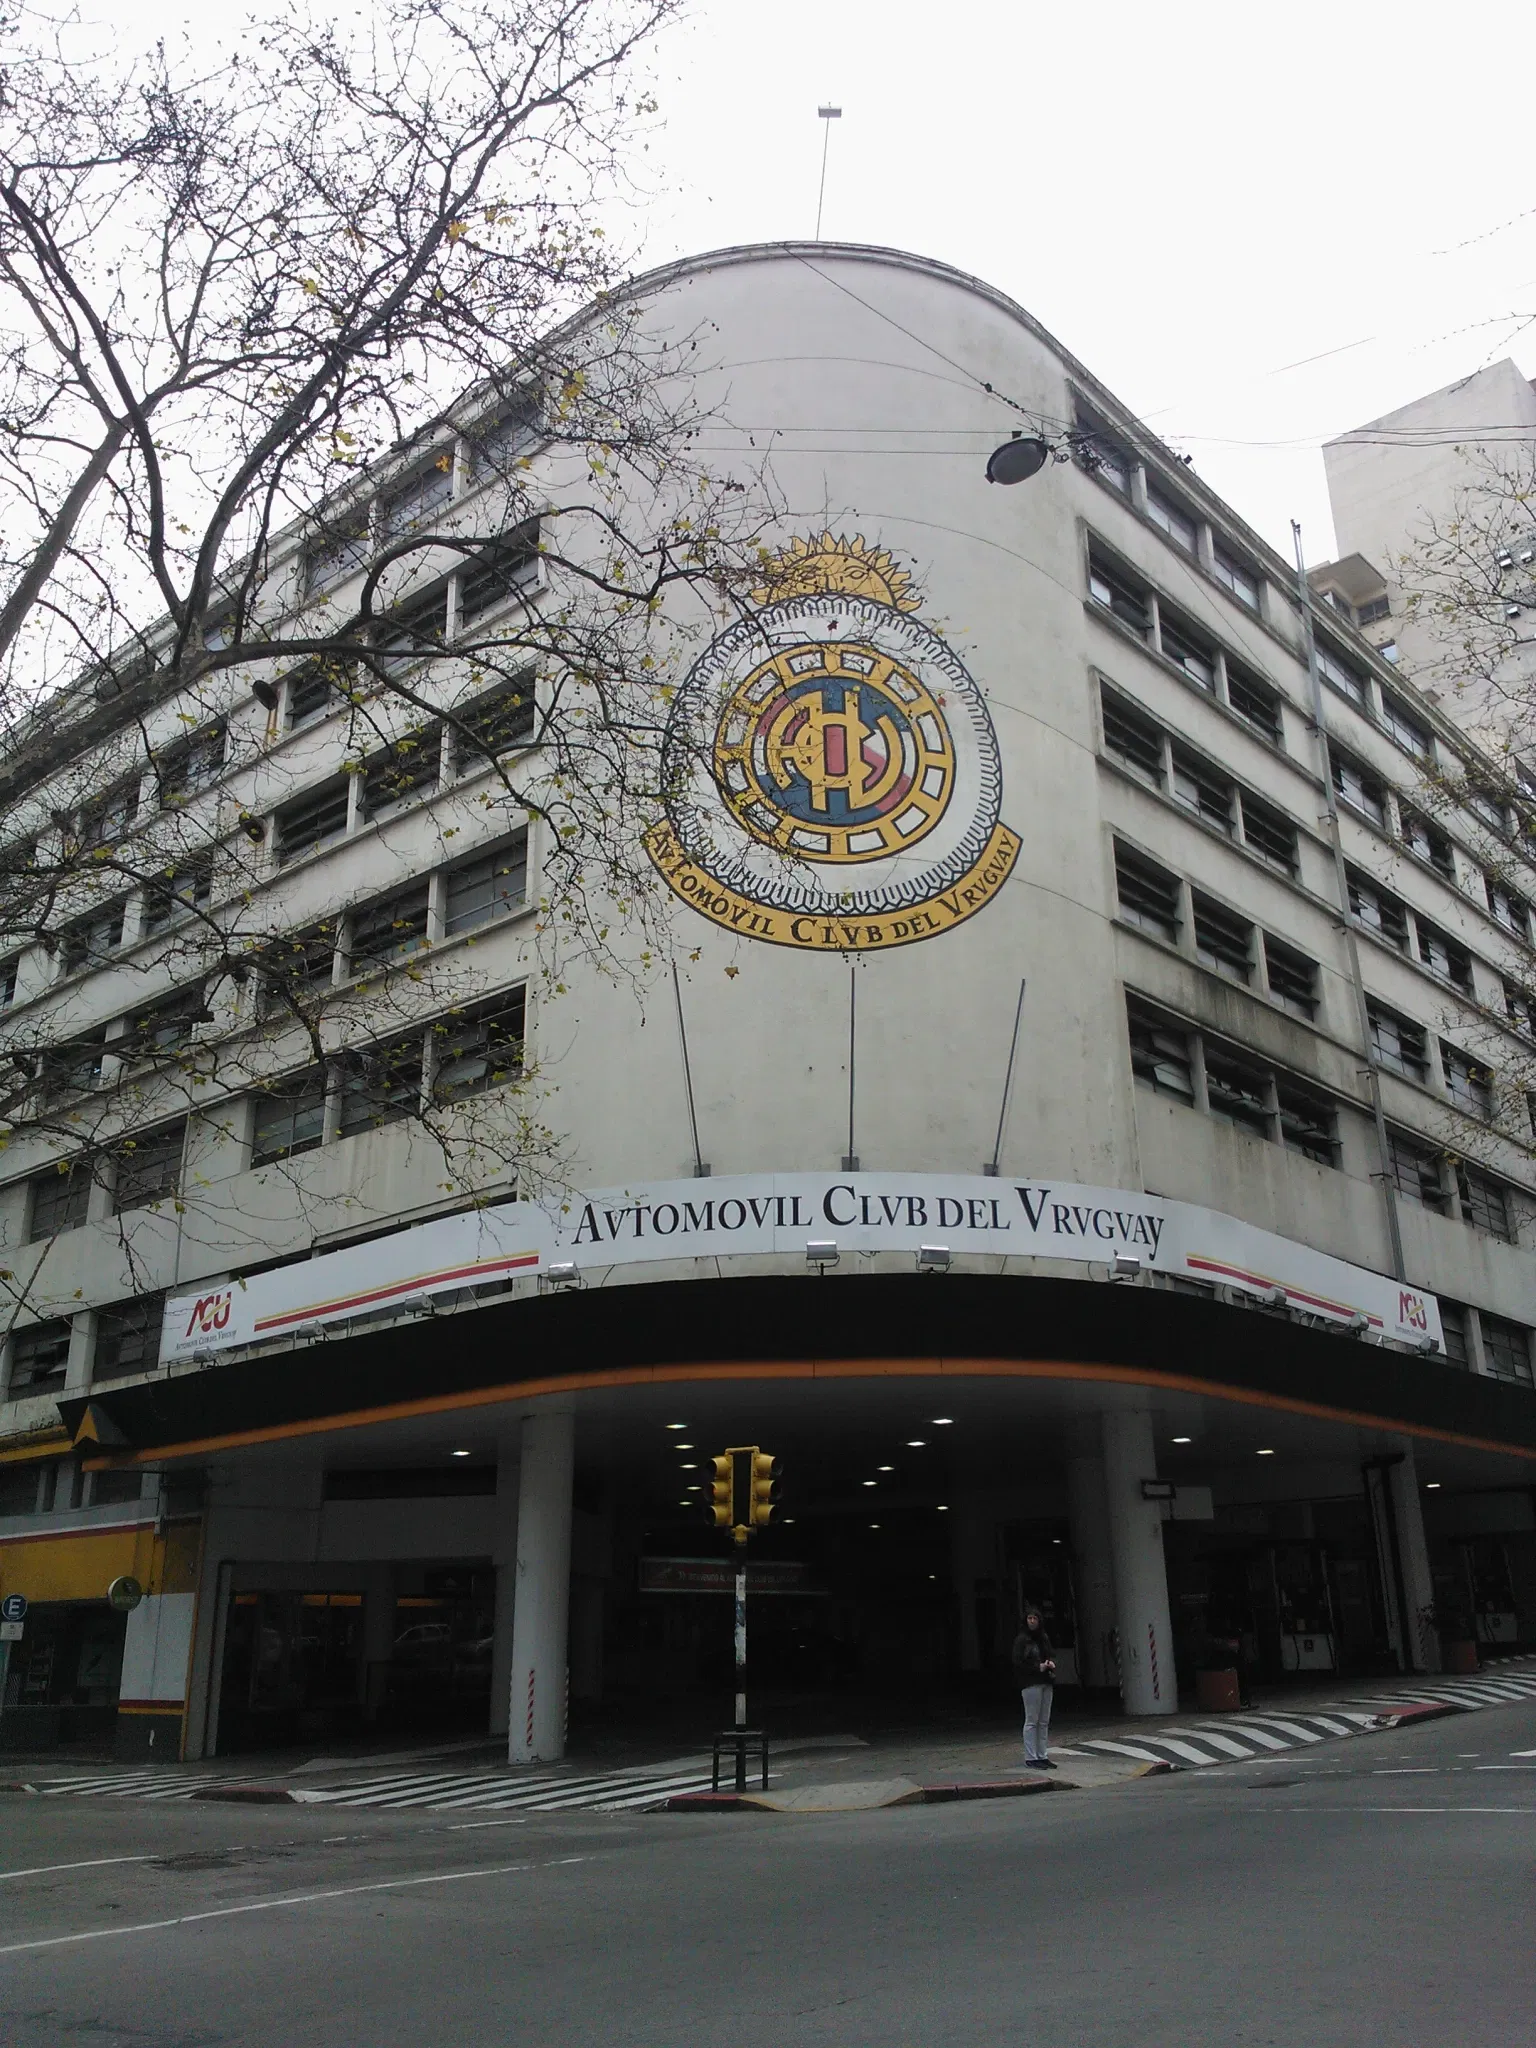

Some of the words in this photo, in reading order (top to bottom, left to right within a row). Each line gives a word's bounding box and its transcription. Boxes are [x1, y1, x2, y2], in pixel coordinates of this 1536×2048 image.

[790, 917, 883, 945] CLVB
[892, 912, 941, 939] DEL
[935, 831, 1015, 918] VRVGVAY
[570, 1196, 813, 1245] AVTOMOVIL
[822, 1185, 929, 1227] CLVB
[935, 1197, 1012, 1231] DEL
[9, 1598, 21, 1615] E
